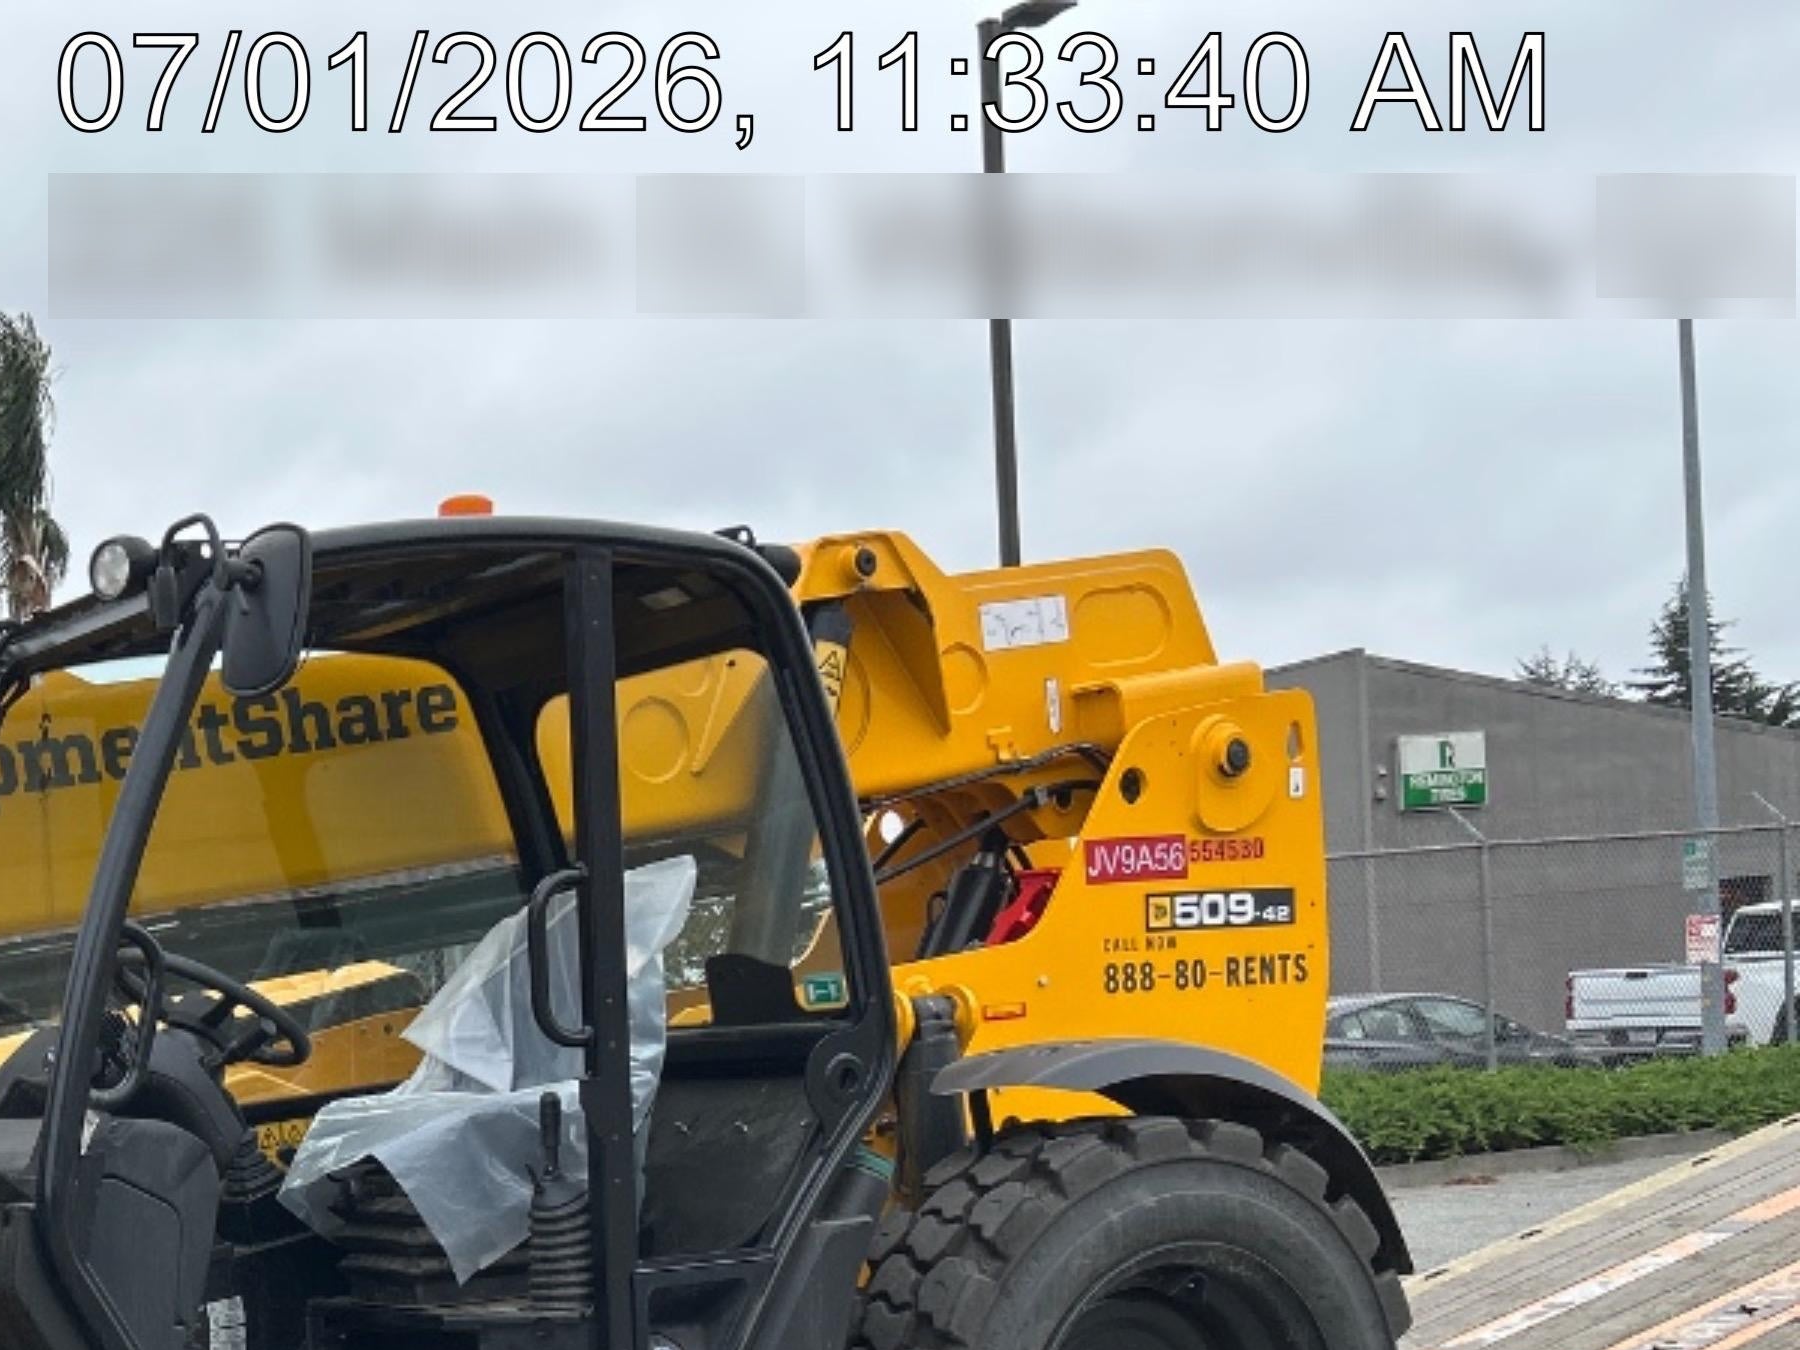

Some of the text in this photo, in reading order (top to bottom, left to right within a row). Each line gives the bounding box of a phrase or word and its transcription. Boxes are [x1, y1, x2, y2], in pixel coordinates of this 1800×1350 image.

[1088, 842, 1184, 877] JV9A56
[1103, 935, 1178, 953] CALL NOW
[1103, 953, 1309, 995] 888-80-RENTS
